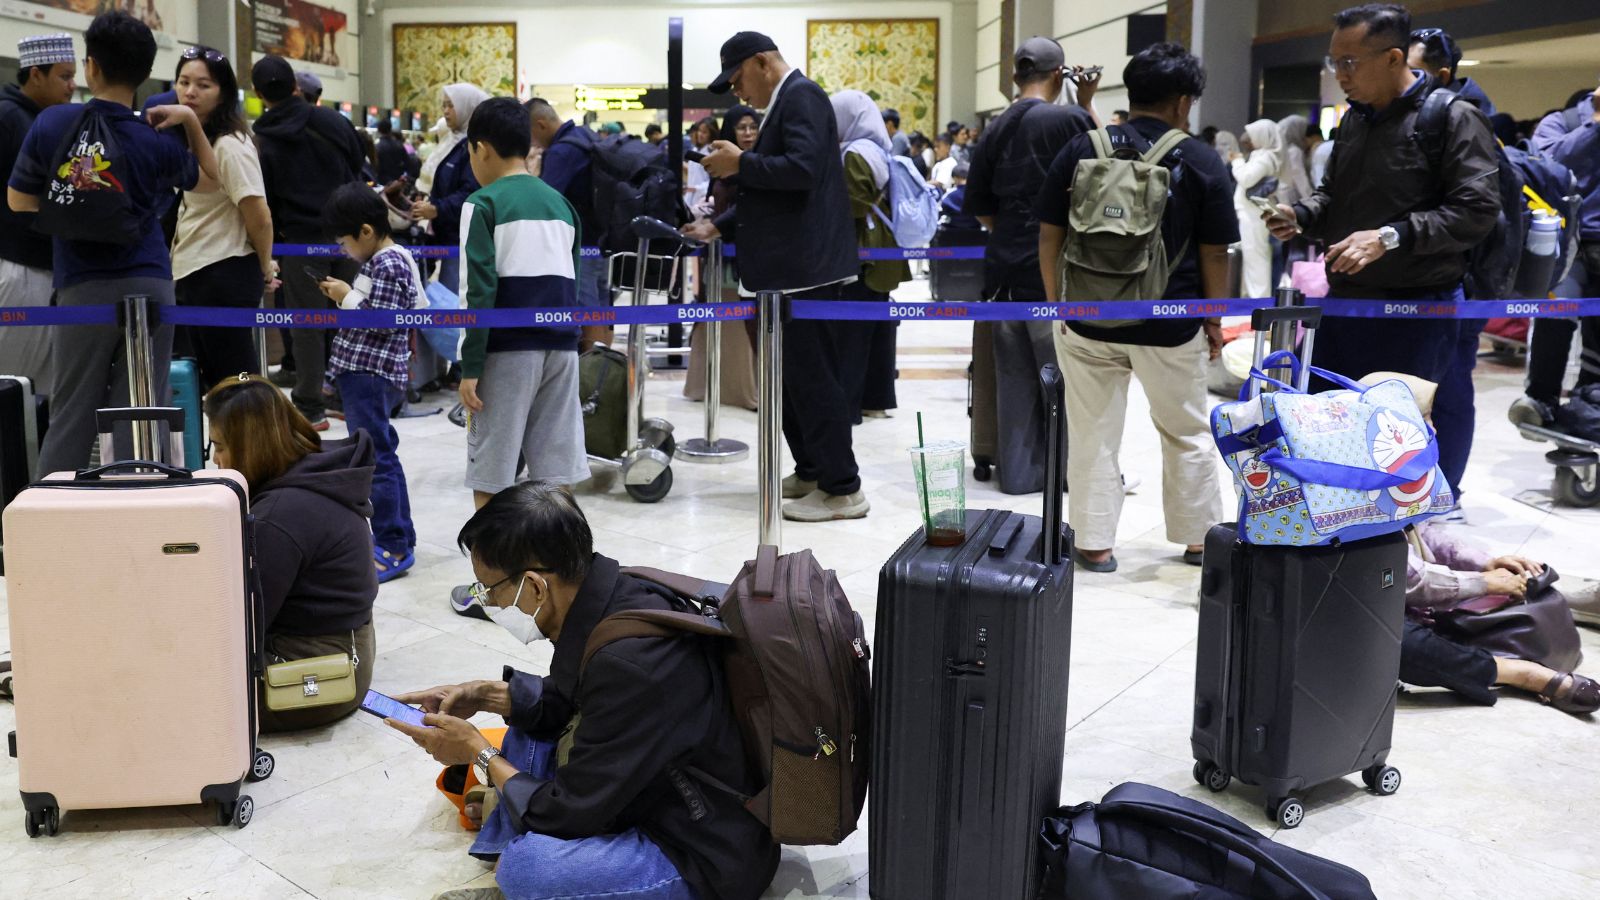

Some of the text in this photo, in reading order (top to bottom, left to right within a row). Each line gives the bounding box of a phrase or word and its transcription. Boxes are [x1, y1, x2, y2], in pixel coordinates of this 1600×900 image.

[678, 306, 757, 319] BOOKCABIN
[889, 306, 967, 317] BOOKCABIN
[1027, 306, 1099, 317] OOKCABIN
[1152, 304, 1227, 315] BOOKCABIN
[1384, 304, 1456, 315] BOOKCABIN
[1506, 302, 1579, 314] BOOKCABIN
[256, 313, 337, 324] BOOKCABIN
[395, 313, 477, 325] BOOKCABIN
[535, 311, 617, 323] BOOKCABIN
